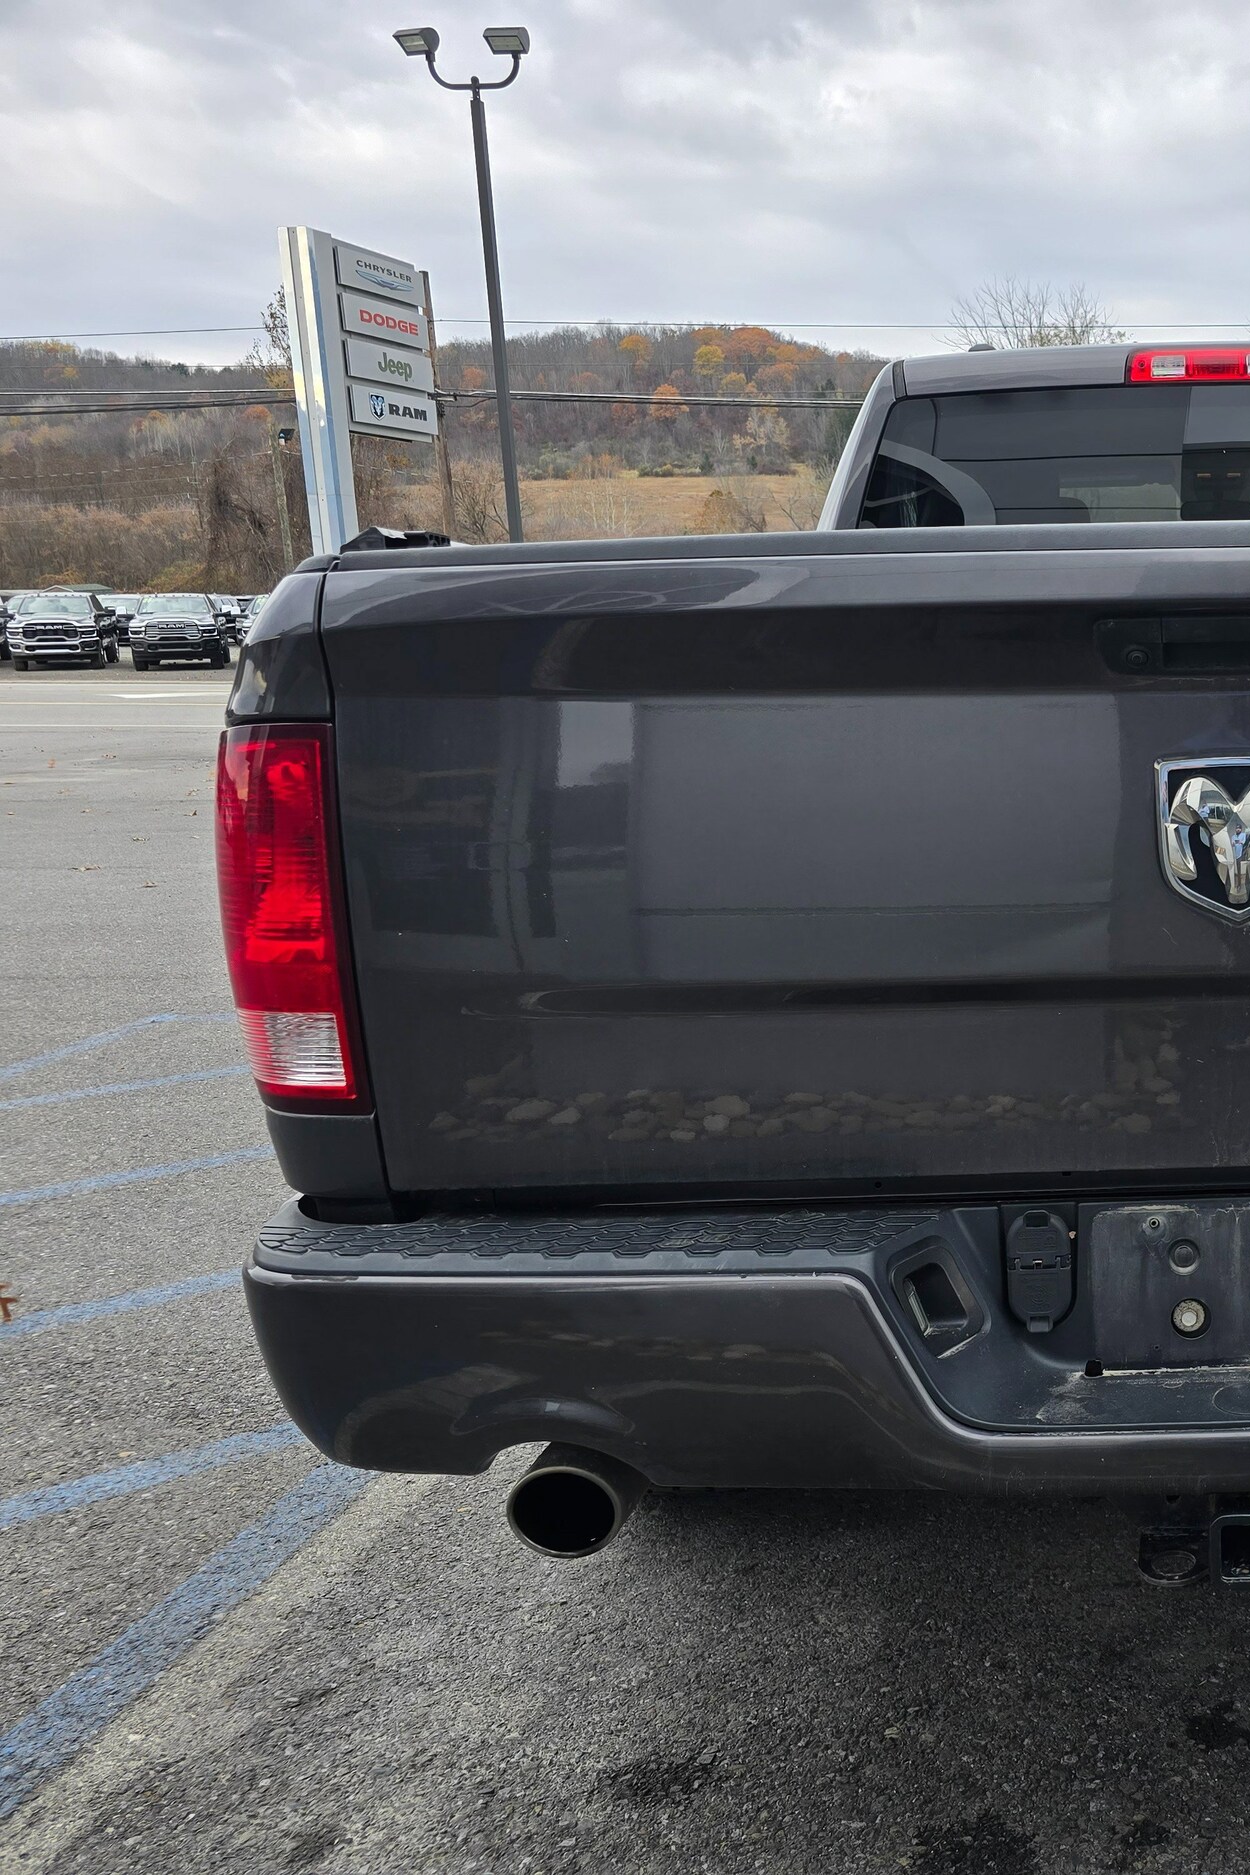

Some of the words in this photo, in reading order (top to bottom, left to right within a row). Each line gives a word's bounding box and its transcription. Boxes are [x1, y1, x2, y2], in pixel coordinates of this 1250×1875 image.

[356, 259, 412, 284] CHRYSLER
[359, 309, 419, 336] DODGE
[377, 351, 413, 382] Jeep
[388, 403, 428, 422] RAM
